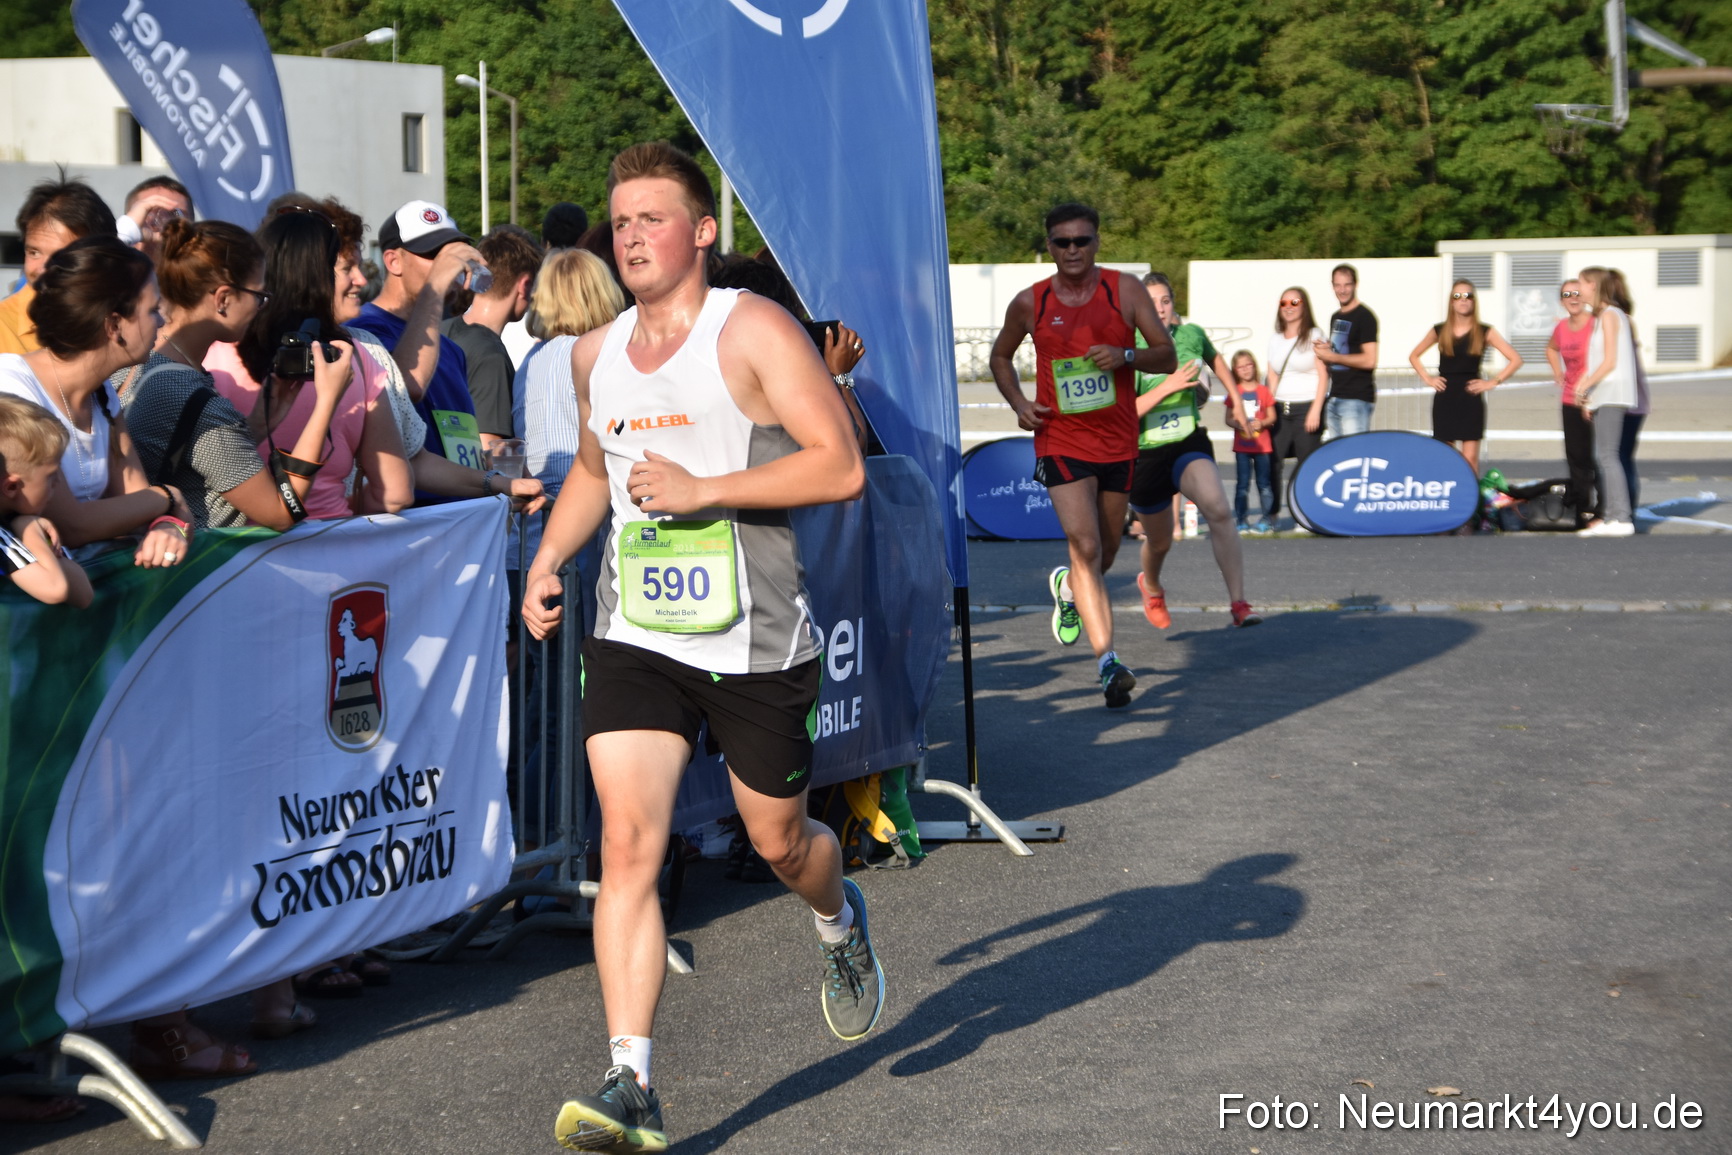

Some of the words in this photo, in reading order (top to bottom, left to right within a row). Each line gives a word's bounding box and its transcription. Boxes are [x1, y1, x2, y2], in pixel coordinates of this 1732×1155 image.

[1061, 374, 1109, 399] 1390
[629, 413, 696, 431] KLEBL
[1160, 412, 1180, 430] 23
[280, 482, 301, 514] SONY
[990, 480, 1015, 496] und
[1018, 477, 1039, 491] das
[1341, 474, 1457, 501] Fischer
[1354, 500, 1450, 513] AUTOMOBILE
[642, 565, 711, 602] 590
[339, 710, 371, 737] 1628
